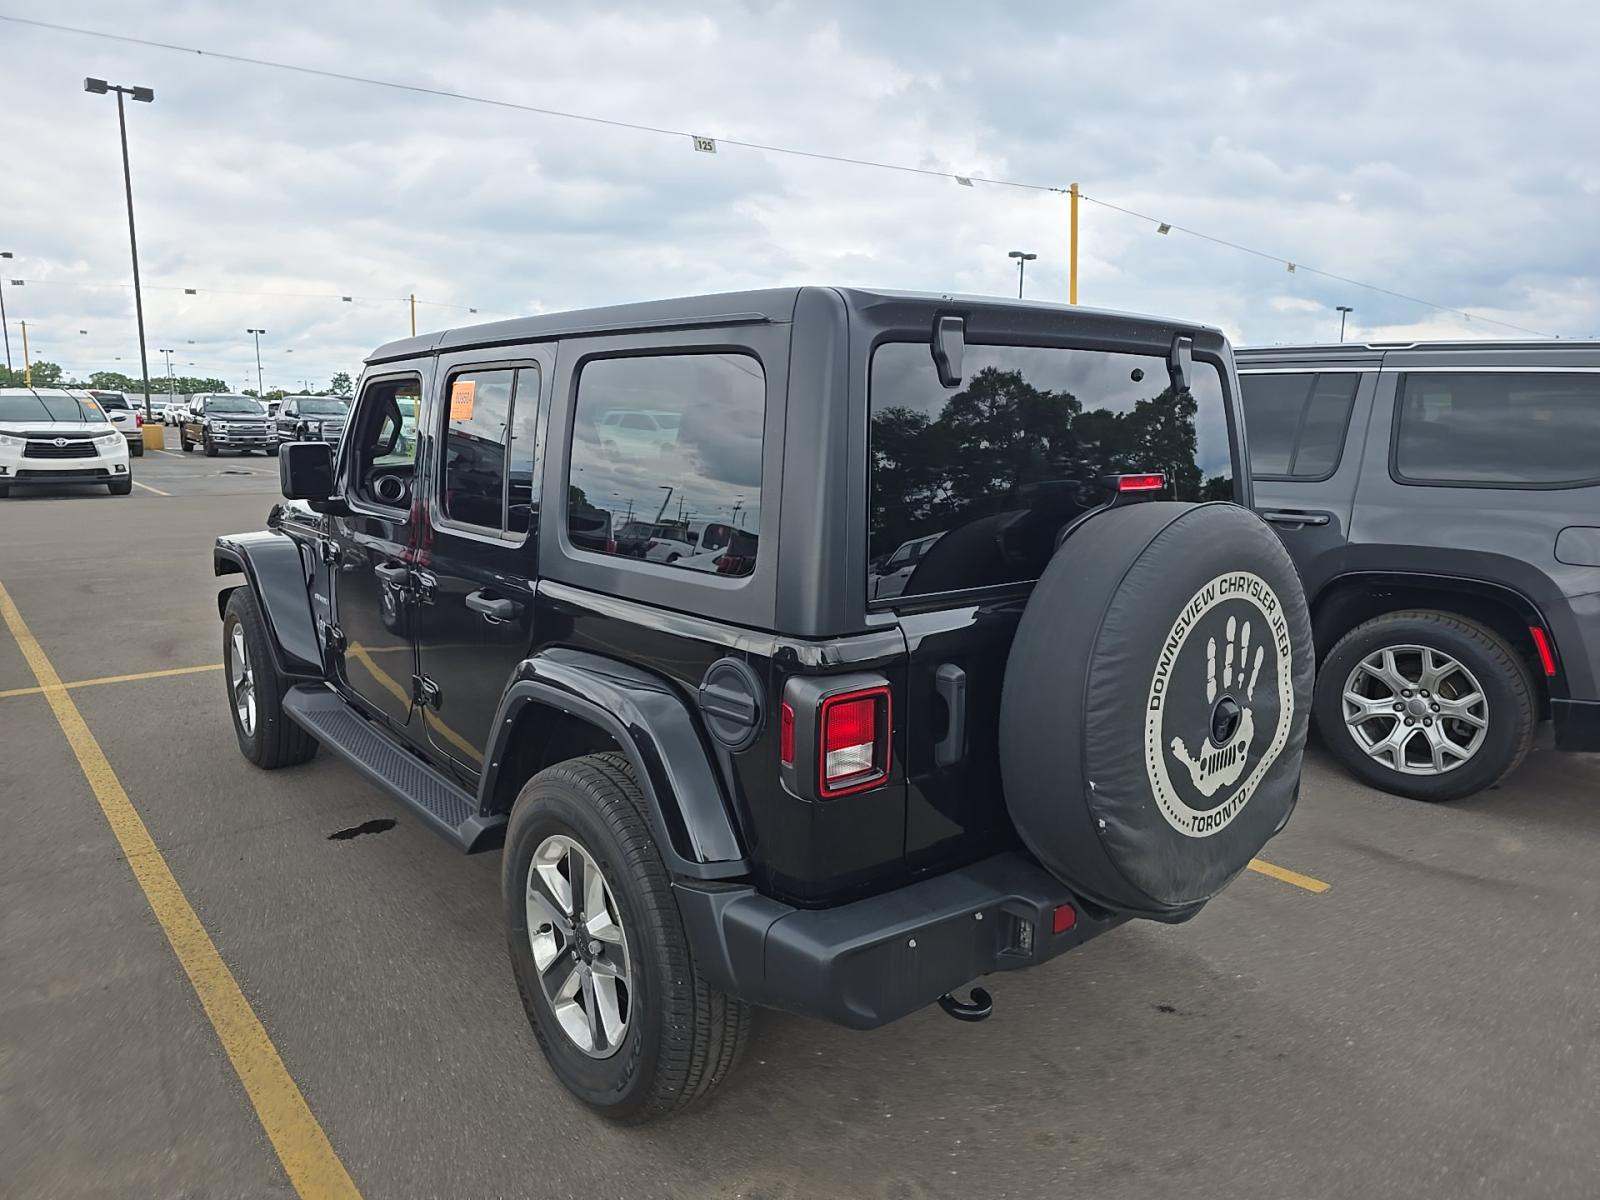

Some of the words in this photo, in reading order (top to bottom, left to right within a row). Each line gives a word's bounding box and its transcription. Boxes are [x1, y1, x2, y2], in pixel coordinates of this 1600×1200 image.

[697, 140, 713, 151] 125
[1149, 584, 1216, 710] DOWNSVIEW
[1219, 576, 1277, 616] CHRYSLER
[1272, 615, 1289, 658] JEEP
[1191, 788, 1247, 832] TORONTO
